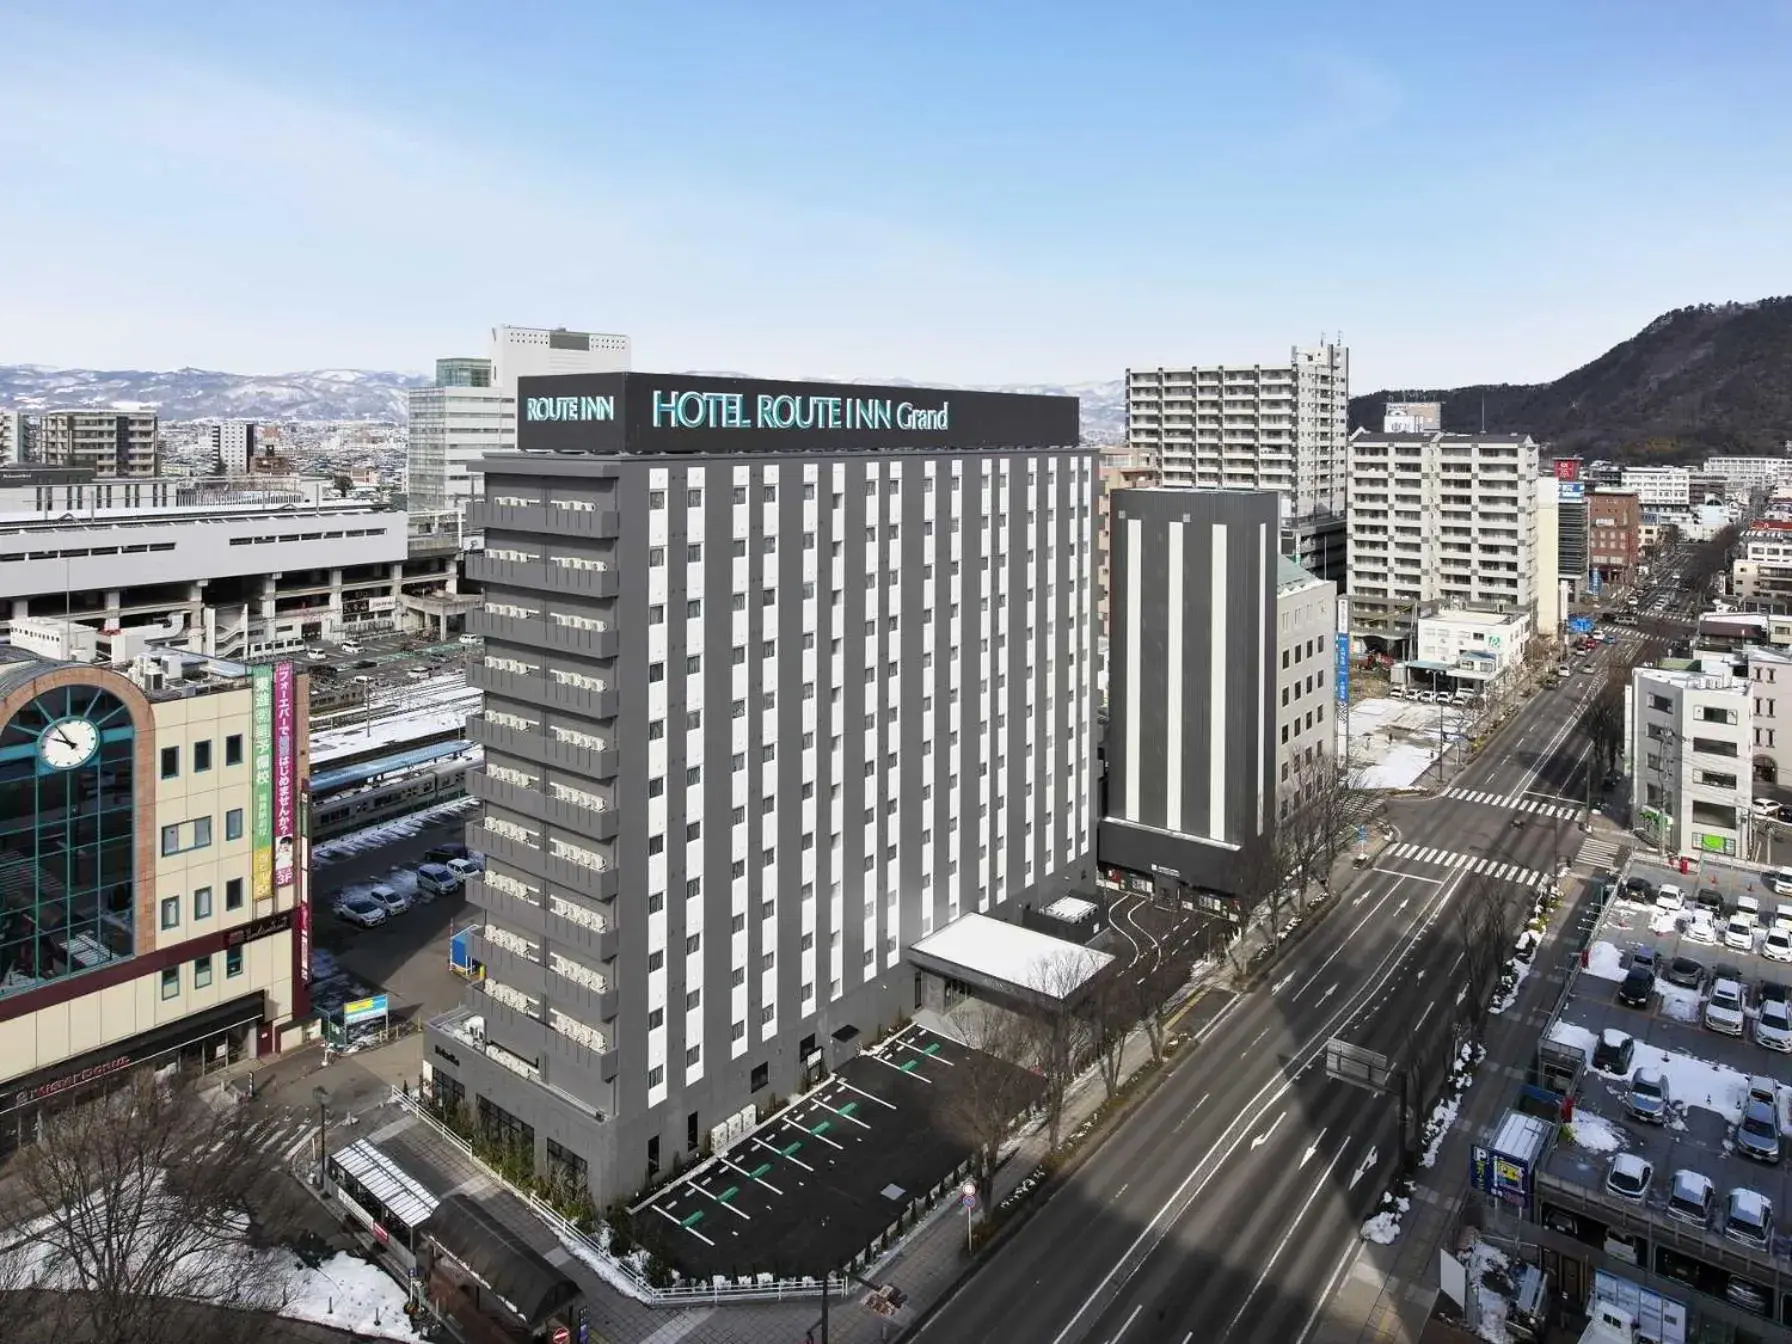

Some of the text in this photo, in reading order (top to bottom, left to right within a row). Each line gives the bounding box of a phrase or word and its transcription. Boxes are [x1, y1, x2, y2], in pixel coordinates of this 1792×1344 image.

[527, 395, 614, 421] ROUTE INN
[652, 390, 949, 430] HOTEL ROUTE INN Grand
[1474, 1146, 1487, 1161] P
